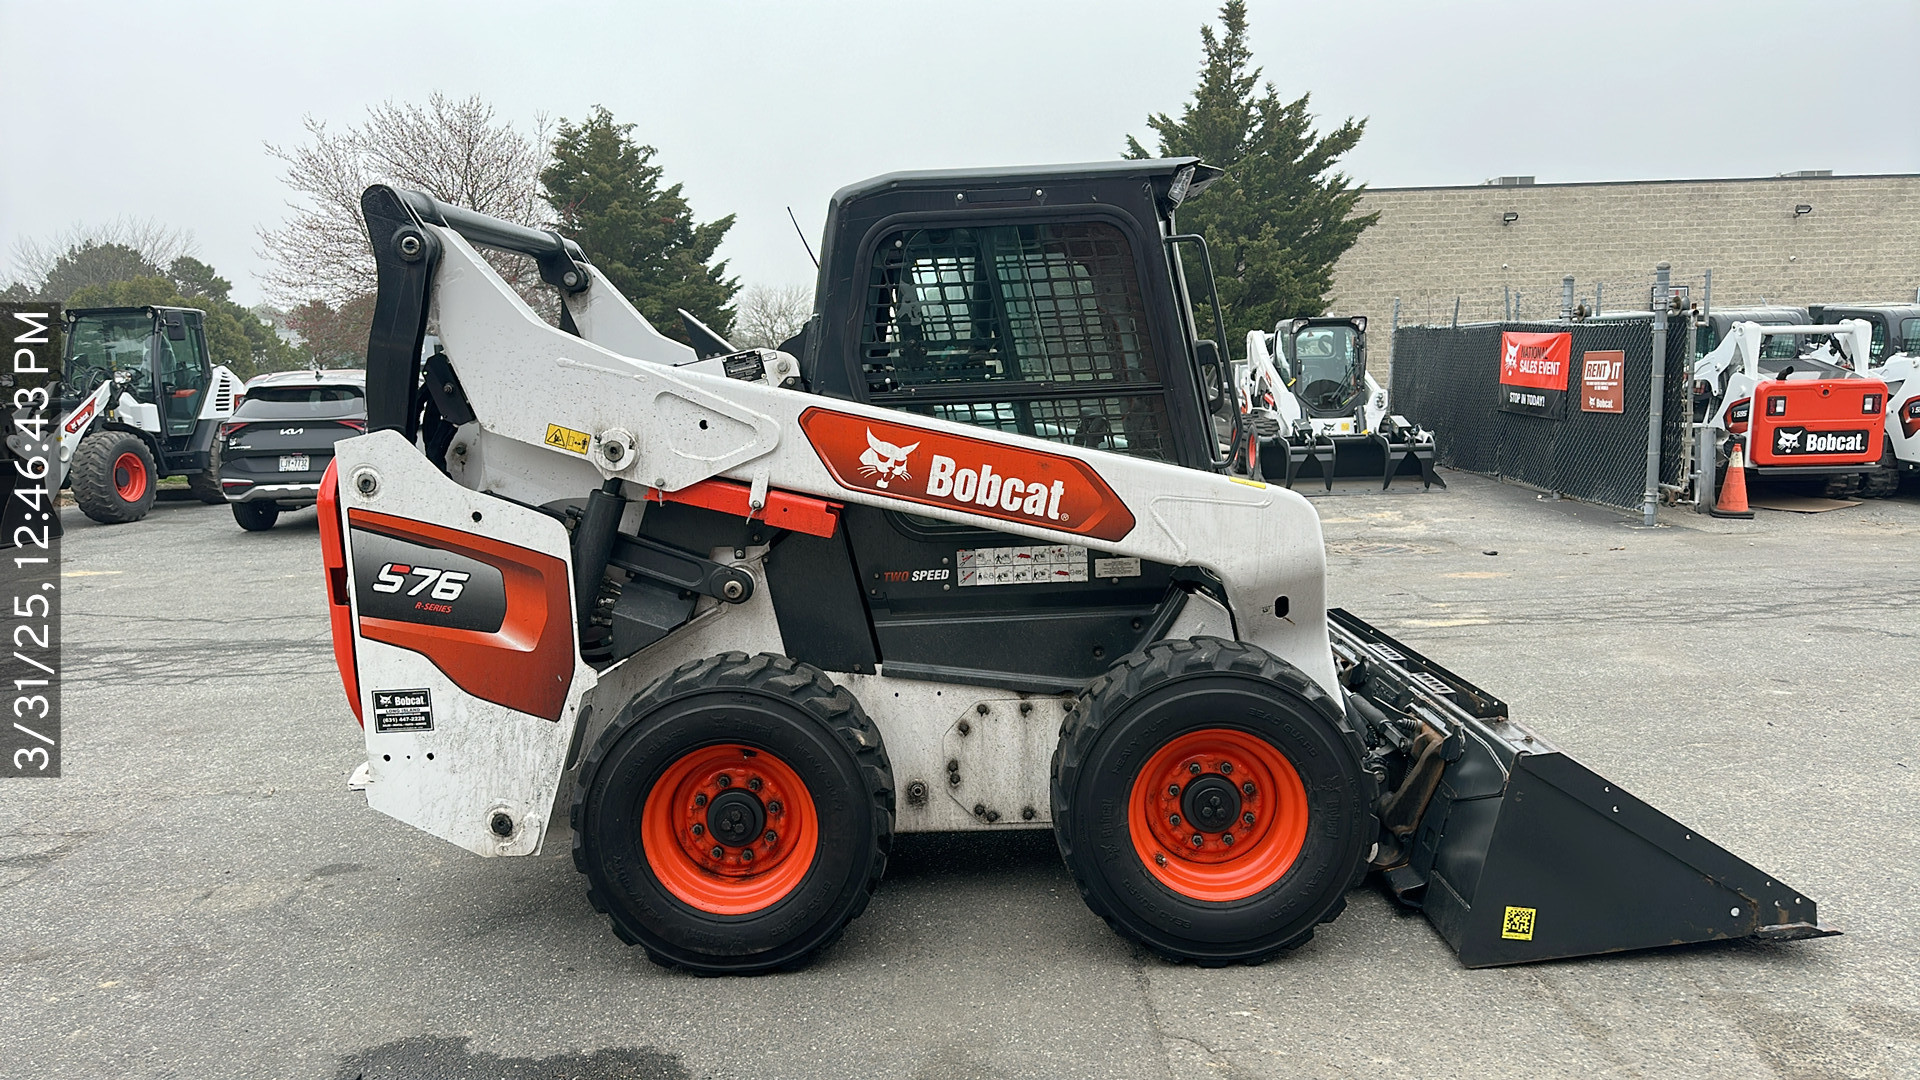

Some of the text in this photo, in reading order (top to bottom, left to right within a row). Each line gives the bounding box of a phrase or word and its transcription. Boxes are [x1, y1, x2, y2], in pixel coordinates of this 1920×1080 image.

[1519, 360, 1560, 375] SALES EVENT
[1586, 362, 1622, 379] RENT IT
[1509, 392, 1545, 407] STOP IN TODAY!
[1806, 432, 1862, 452] Bobcat
[926, 454, 1064, 520] Bobcat
[373, 563, 470, 600] S76
[884, 569, 949, 582] TWO SPEED
[415, 602, 452, 614] R-SERIES
[394, 696, 424, 706] Bobcat
